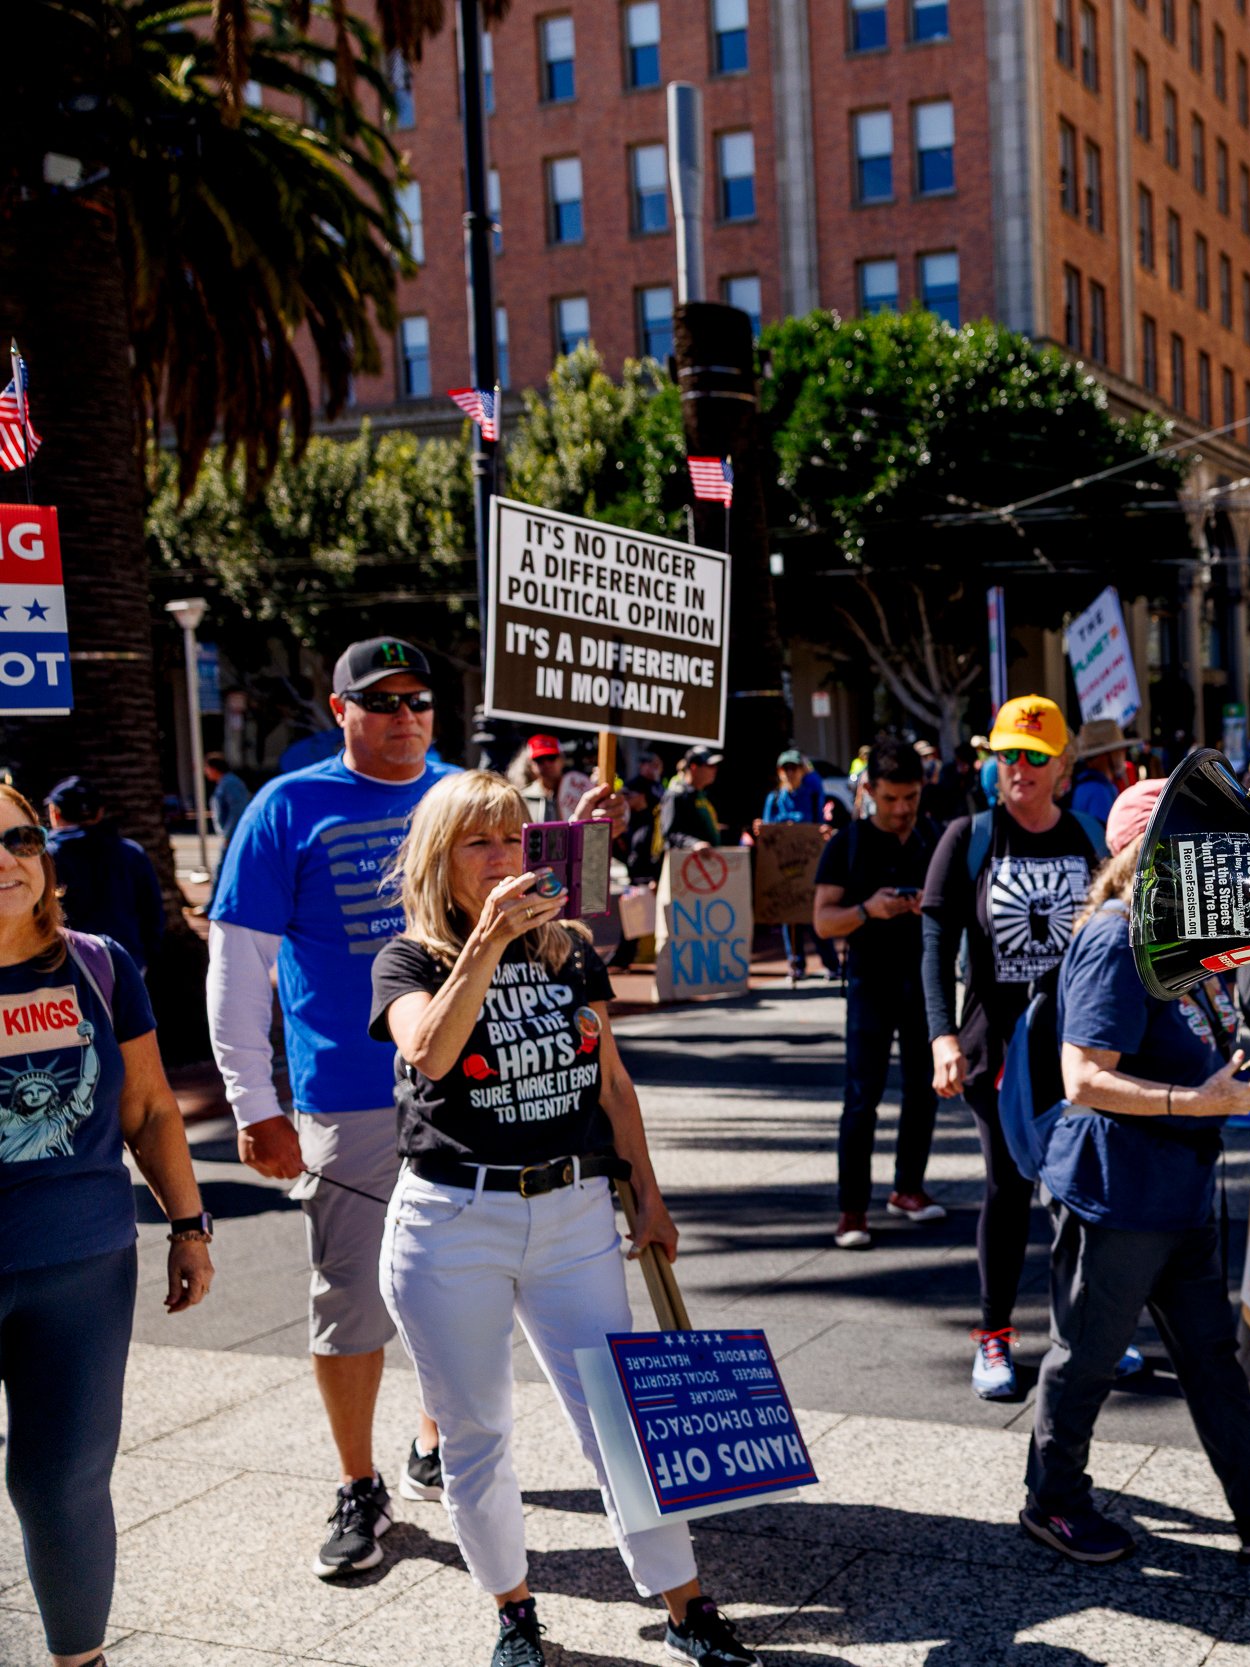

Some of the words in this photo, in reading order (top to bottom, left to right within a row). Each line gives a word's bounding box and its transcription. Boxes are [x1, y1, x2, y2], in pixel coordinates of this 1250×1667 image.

[526, 519, 565, 550] IT'S
[574, 531, 606, 559] NO
[616, 540, 695, 581] LONGER
[520, 549, 535, 574] A
[544, 554, 677, 604] DIFFERENCE
[685, 586, 705, 611] IN
[508, 576, 620, 621] POLITICAL
[628, 602, 714, 641] OPINION
[506, 622, 549, 659] IT'S
[555, 632, 574, 664] A
[580, 636, 714, 688] DIFFERENCE
[535, 666, 564, 700] IN
[571, 671, 686, 719] MORALITY.
[1201, 842, 1215, 868] Until
[1216, 854, 1228, 865] In
[1182, 848, 1198, 935] RefuseFascism.org
[1203, 870, 1218, 911] They're
[1217, 867, 1230, 885] the
[672, 898, 736, 937] NO
[1219, 887, 1232, 926] Streets
[1207, 913, 1219, 938] Gone
[670, 937, 750, 986] KINGS
[3, 998, 79, 1036] KINGS
[487, 1019, 527, 1046] BUT
[526, 1010, 570, 1034] THE
[496, 1031, 576, 1082] HATS
[469, 1083, 513, 1109] SURE
[516, 1074, 557, 1100] MAKE
[557, 1070, 568, 1094] IT
[570, 1063, 598, 1090] EASY
[494, 1105, 516, 1124] TO
[520, 1090, 581, 1122] IDENTIFY
[625, 1354, 691, 1370] HEALTHCARE
[713, 1350, 748, 1363] BODIES
[747, 1349, 768, 1361] OUR
[633, 1373, 683, 1389] SECURITY
[683, 1370, 720, 1384] SOCIAL
[732, 1367, 774, 1381] REFUGEES
[689, 1388, 738, 1405] MEDICARE
[755, 1405, 790, 1424] OUR
[646, 1409, 753, 1441] DEMOCRACY
[656, 1447, 711, 1489] OFF
[717, 1434, 806, 1477] HANDS
